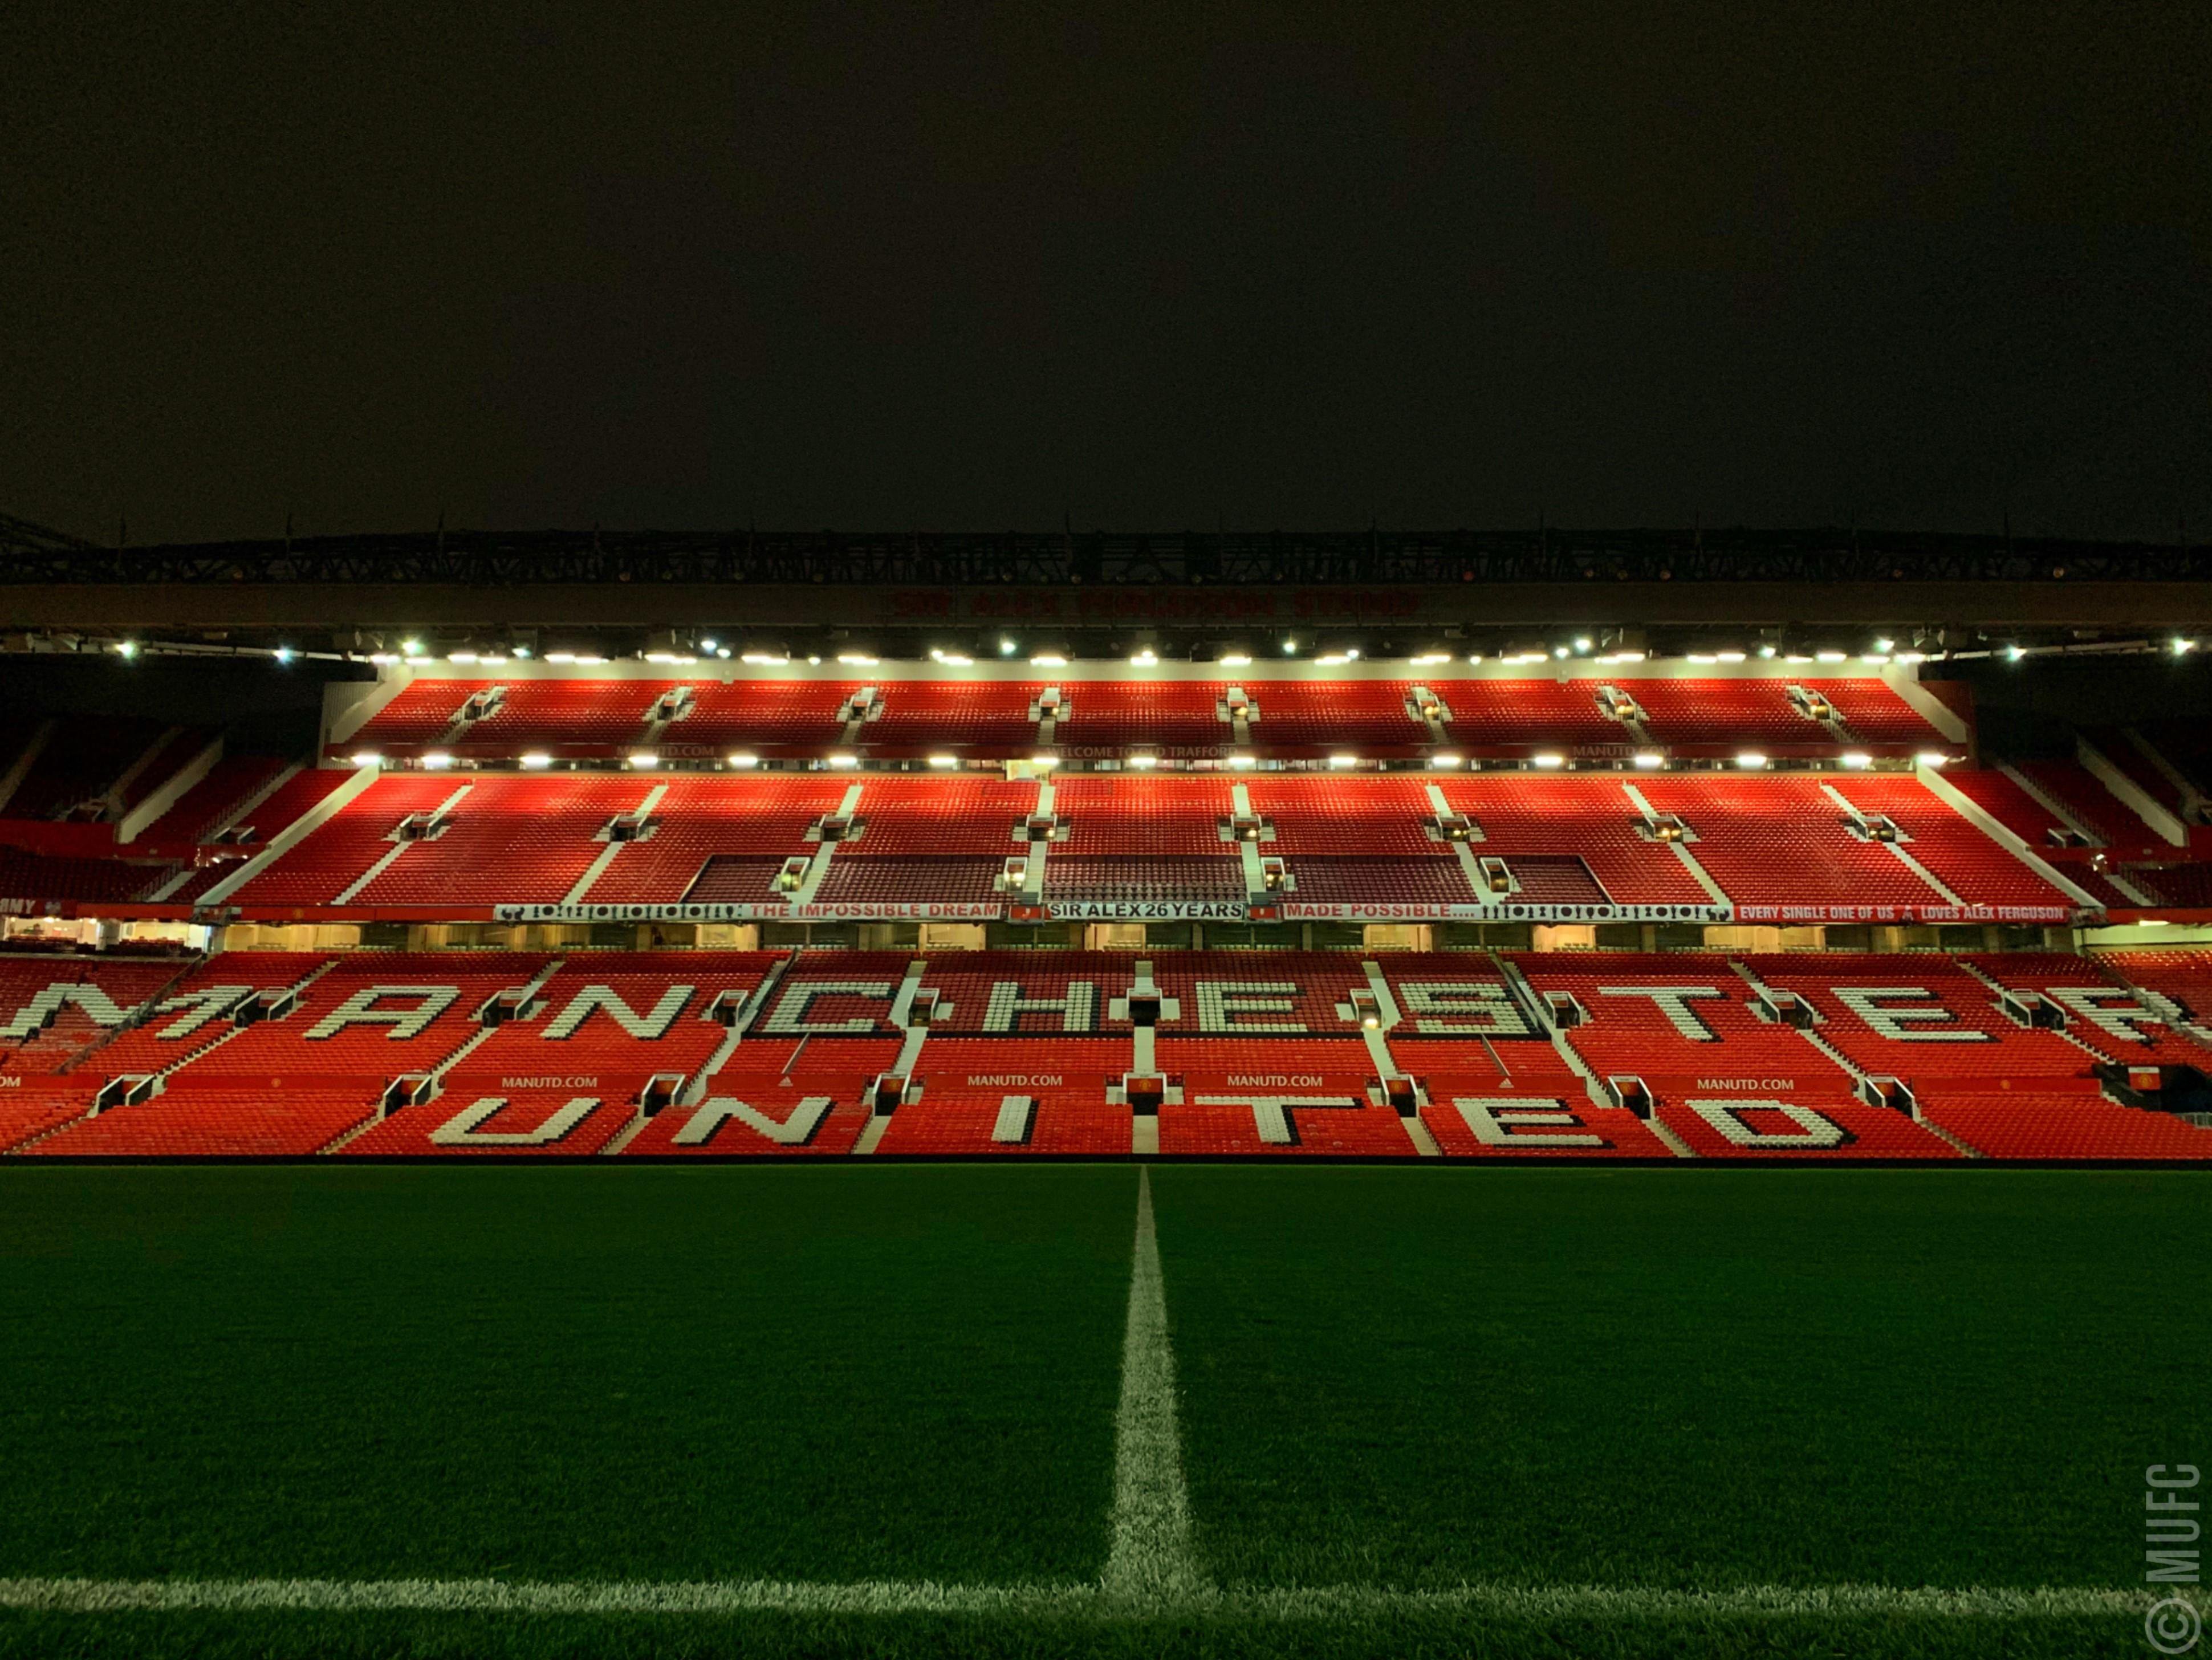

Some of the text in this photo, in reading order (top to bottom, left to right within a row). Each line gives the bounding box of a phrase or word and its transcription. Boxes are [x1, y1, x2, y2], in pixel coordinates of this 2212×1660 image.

[1048, 746, 1113, 757] WELCOME
[1116, 746, 1134, 757] TO
[1168, 746, 1238, 757] TRAFFORD
[751, 904, 998, 917] THE IMPOSSIBLE DREAM
[1051, 904, 1242, 917] SIR ALEX 26 YEARS
[1287, 904, 1343, 917] MADE
[1740, 906, 1894, 919] EVERY SINGLE ONE OF US
[1921, 906, 2064, 919] LOVES ALEX FERGUSON
[502, 1077, 597, 1088] MANUTD.COM
[967, 1075, 1062, 1087] MANUTD.COM
[1227, 1075, 1323, 1088] MANUTD.COM
[1697, 1079, 1794, 1091] MANUTD.COM
